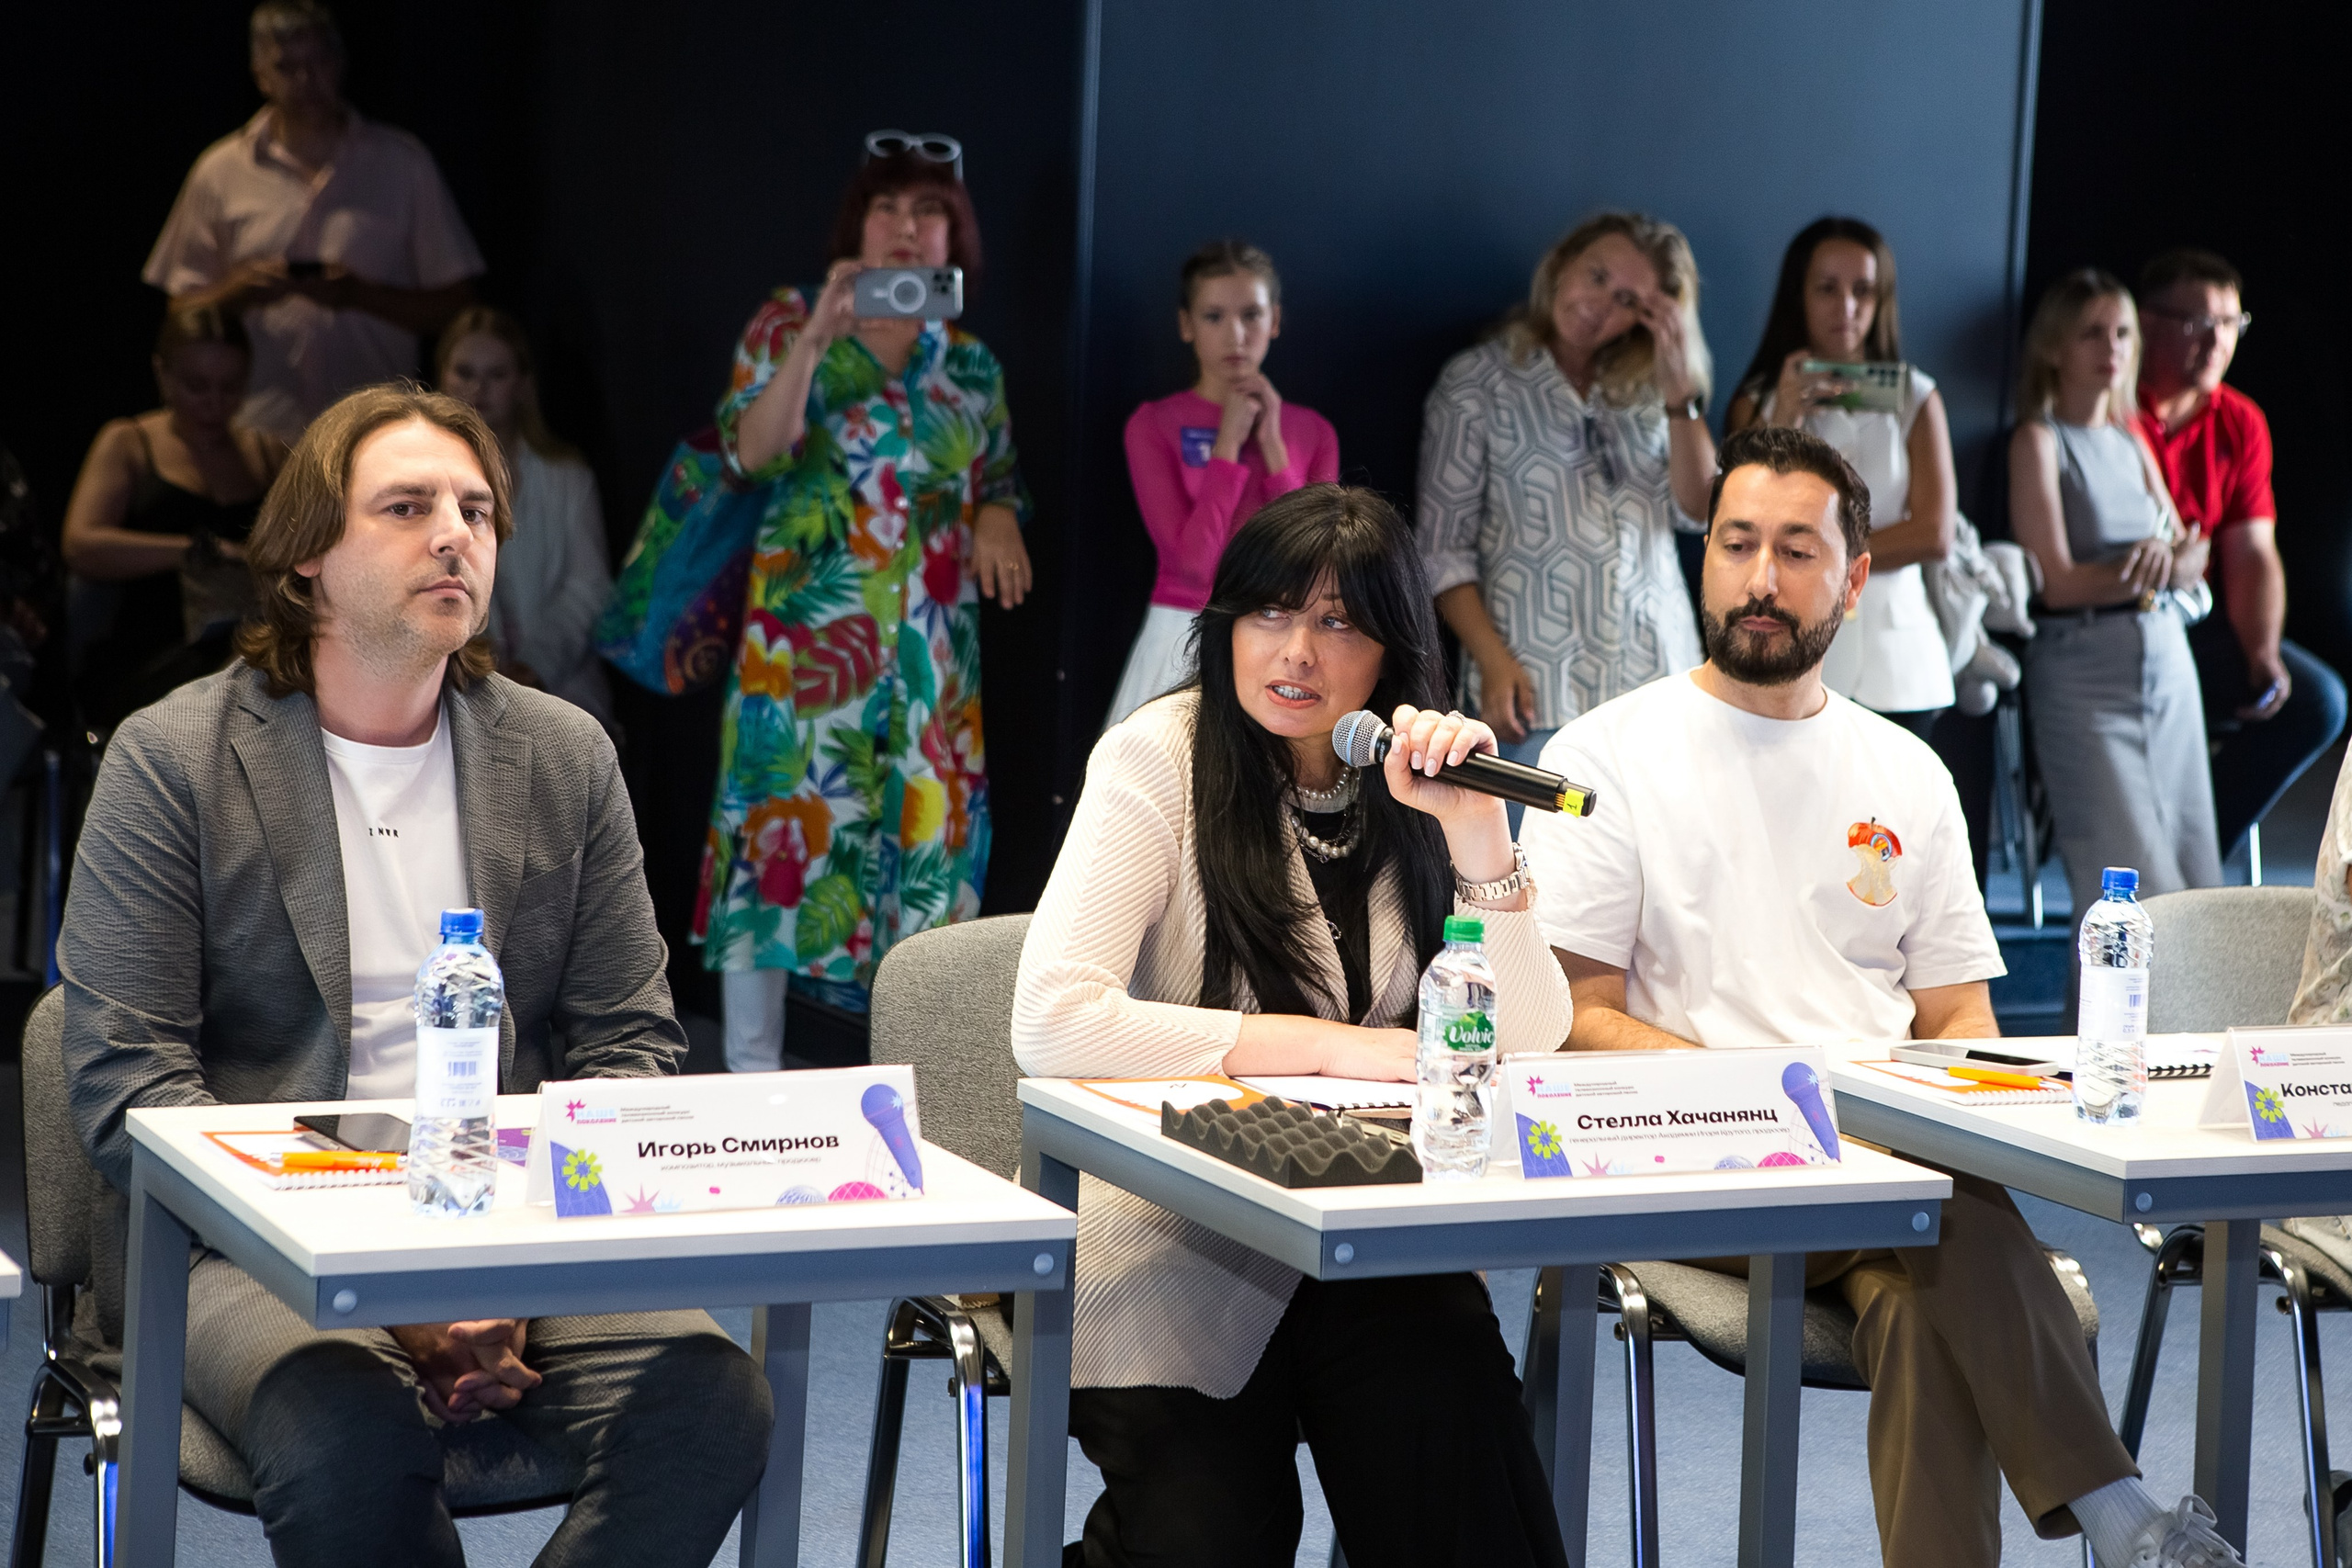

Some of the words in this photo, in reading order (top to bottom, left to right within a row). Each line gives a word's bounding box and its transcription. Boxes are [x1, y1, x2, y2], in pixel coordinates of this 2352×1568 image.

[1449, 1025, 1495, 1043] Volvic
[2280, 1083, 2352, 1098] Конста
[1577, 1114, 1663, 1130] Стелла
[1667, 1109, 1778, 1125] Хачанянц
[638, 1141, 717, 1158] Игорь
[721, 1135, 840, 1153] Смирнов
